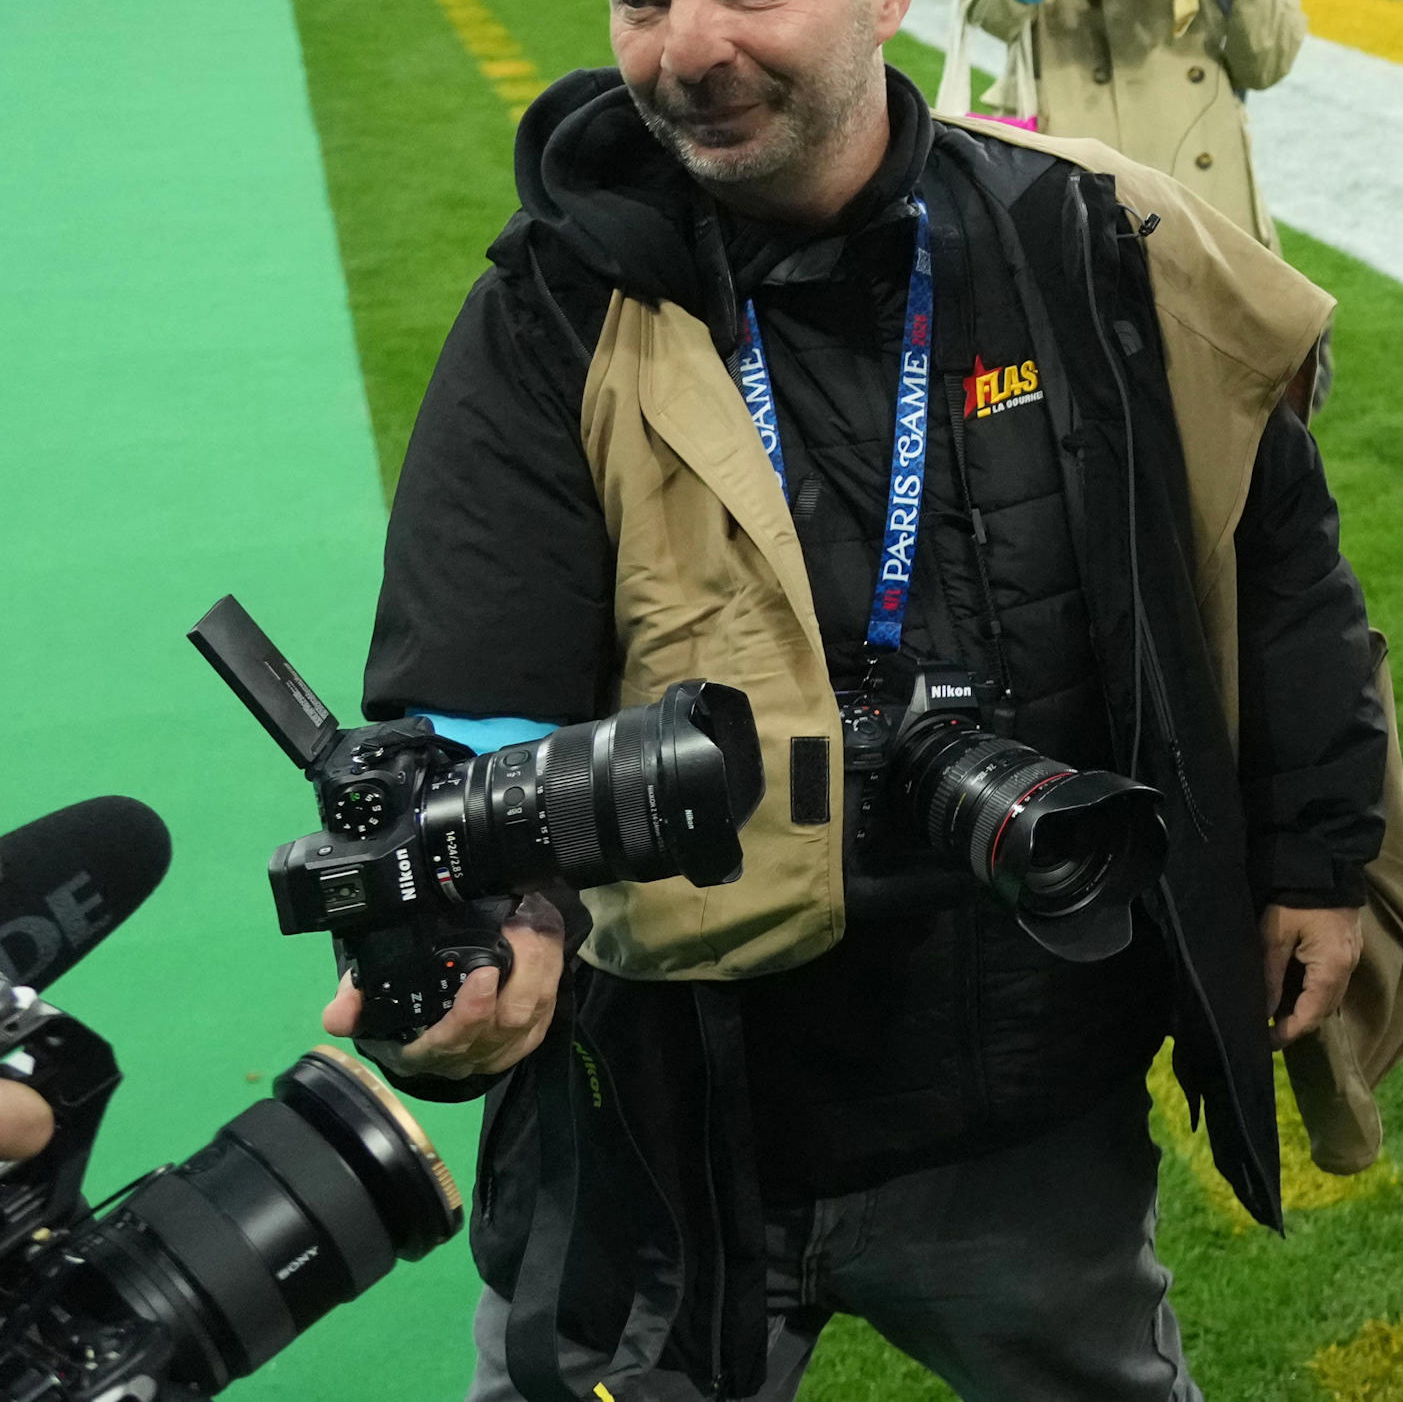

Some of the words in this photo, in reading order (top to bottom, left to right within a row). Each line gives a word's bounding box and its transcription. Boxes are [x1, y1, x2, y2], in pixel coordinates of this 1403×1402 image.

[897, 350, 928, 467] GAME
[992, 402, 1005, 413] LA
[882, 474, 922, 583] PARIS
[931, 684, 972, 699] Nikon
[506, 806, 523, 816] DISP
[684, 808, 695, 830] Nikon
[445, 830, 462, 872] 14-24/2.8
[395, 847, 417, 902] Nikon
[275, 1245, 319, 1281] SONY
